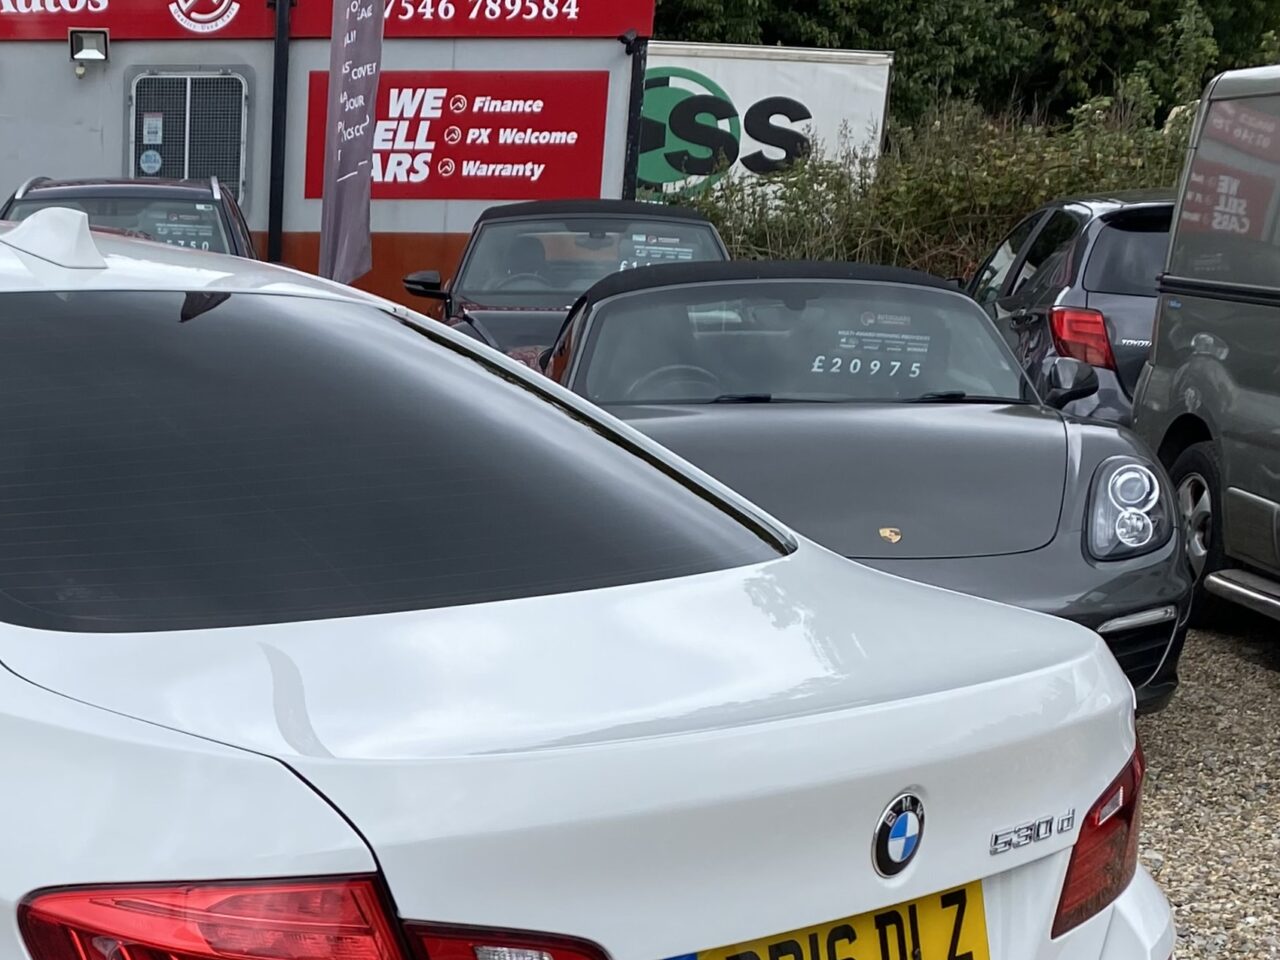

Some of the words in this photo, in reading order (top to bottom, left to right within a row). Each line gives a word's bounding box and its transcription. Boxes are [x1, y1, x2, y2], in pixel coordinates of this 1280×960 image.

[388, 88, 448, 118] WE
[472, 96, 545, 113] Finance
[373, 120, 436, 150] ELL
[466, 128, 492, 144] PX
[498, 128, 579, 145] Welcome
[370, 152, 433, 182] ARS
[461, 160, 546, 181] Warranty
[811, 355, 921, 377] £20975
